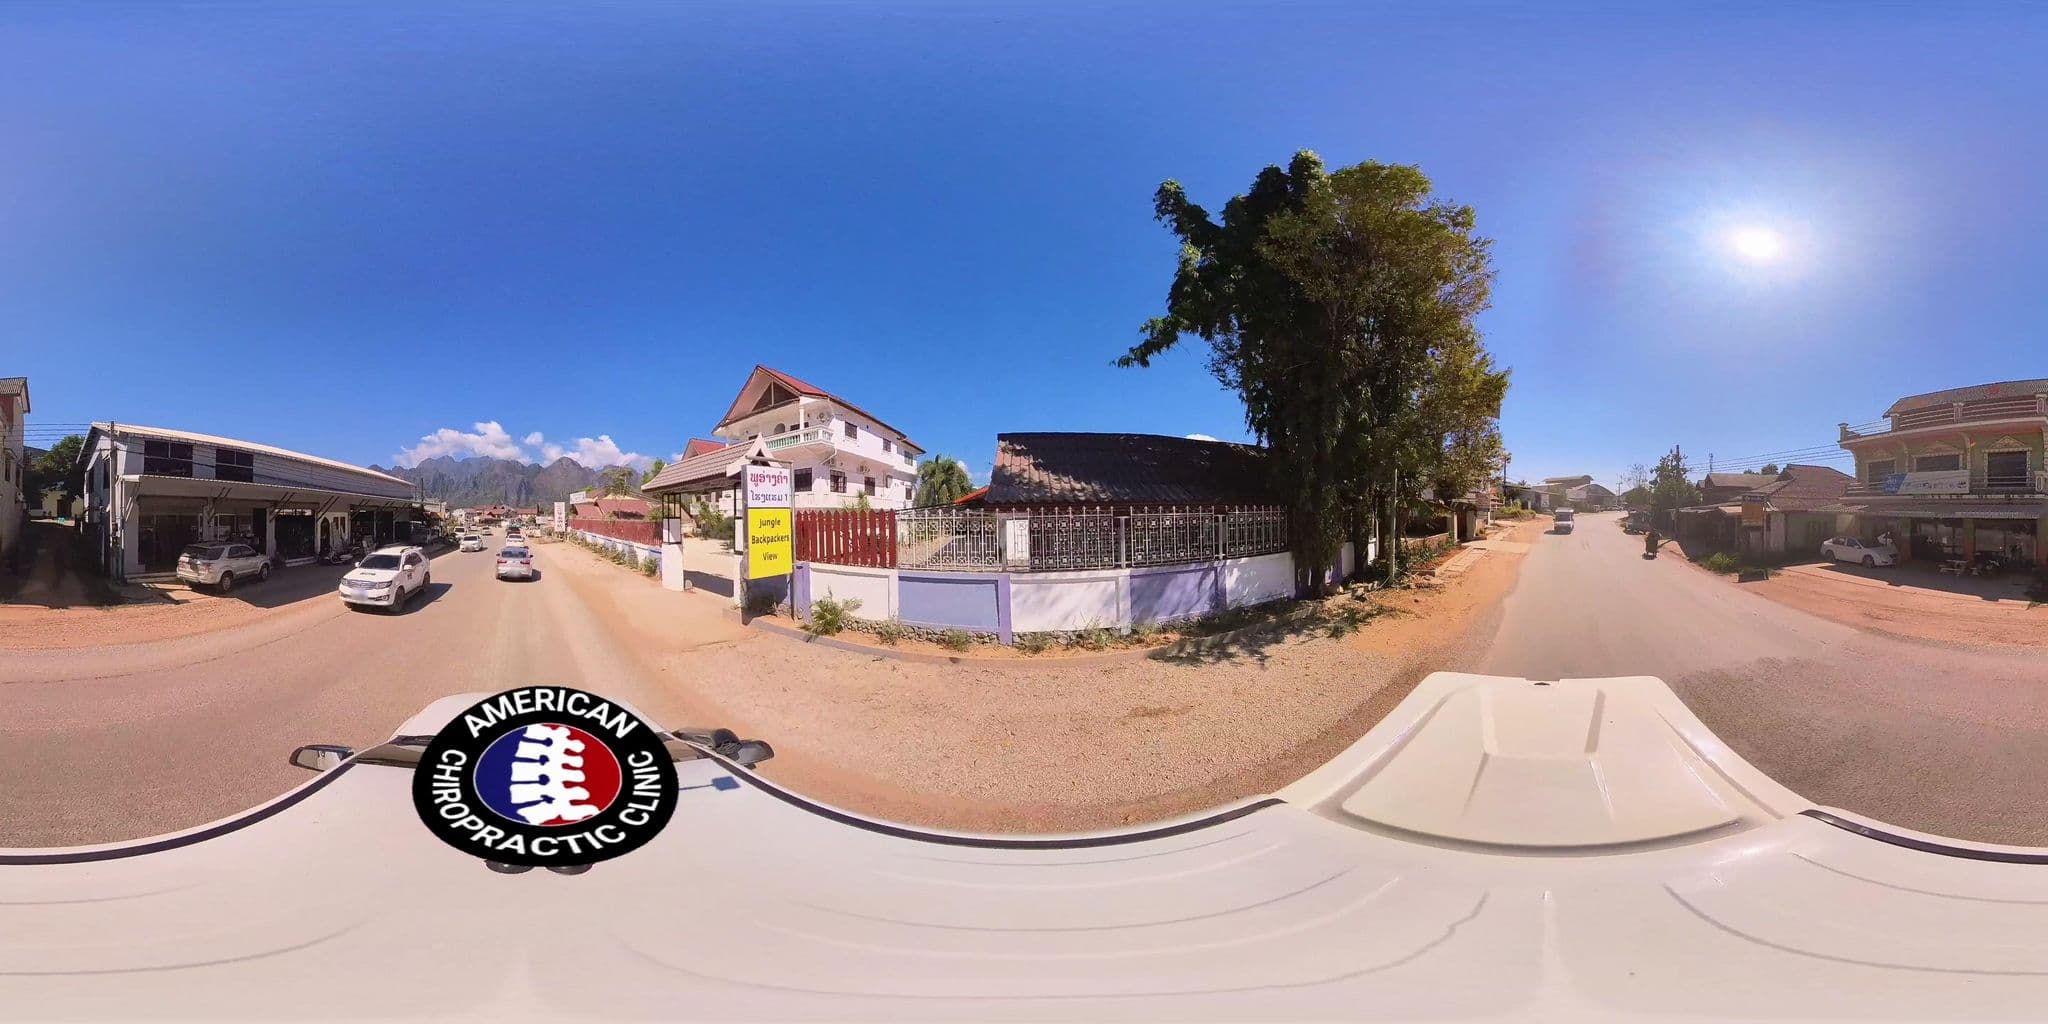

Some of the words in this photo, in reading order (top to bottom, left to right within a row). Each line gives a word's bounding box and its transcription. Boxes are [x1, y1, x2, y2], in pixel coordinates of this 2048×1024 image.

[759, 517, 781, 529] Jungle
[751, 532, 790, 545] Backpackers
[762, 552, 778, 561] View
